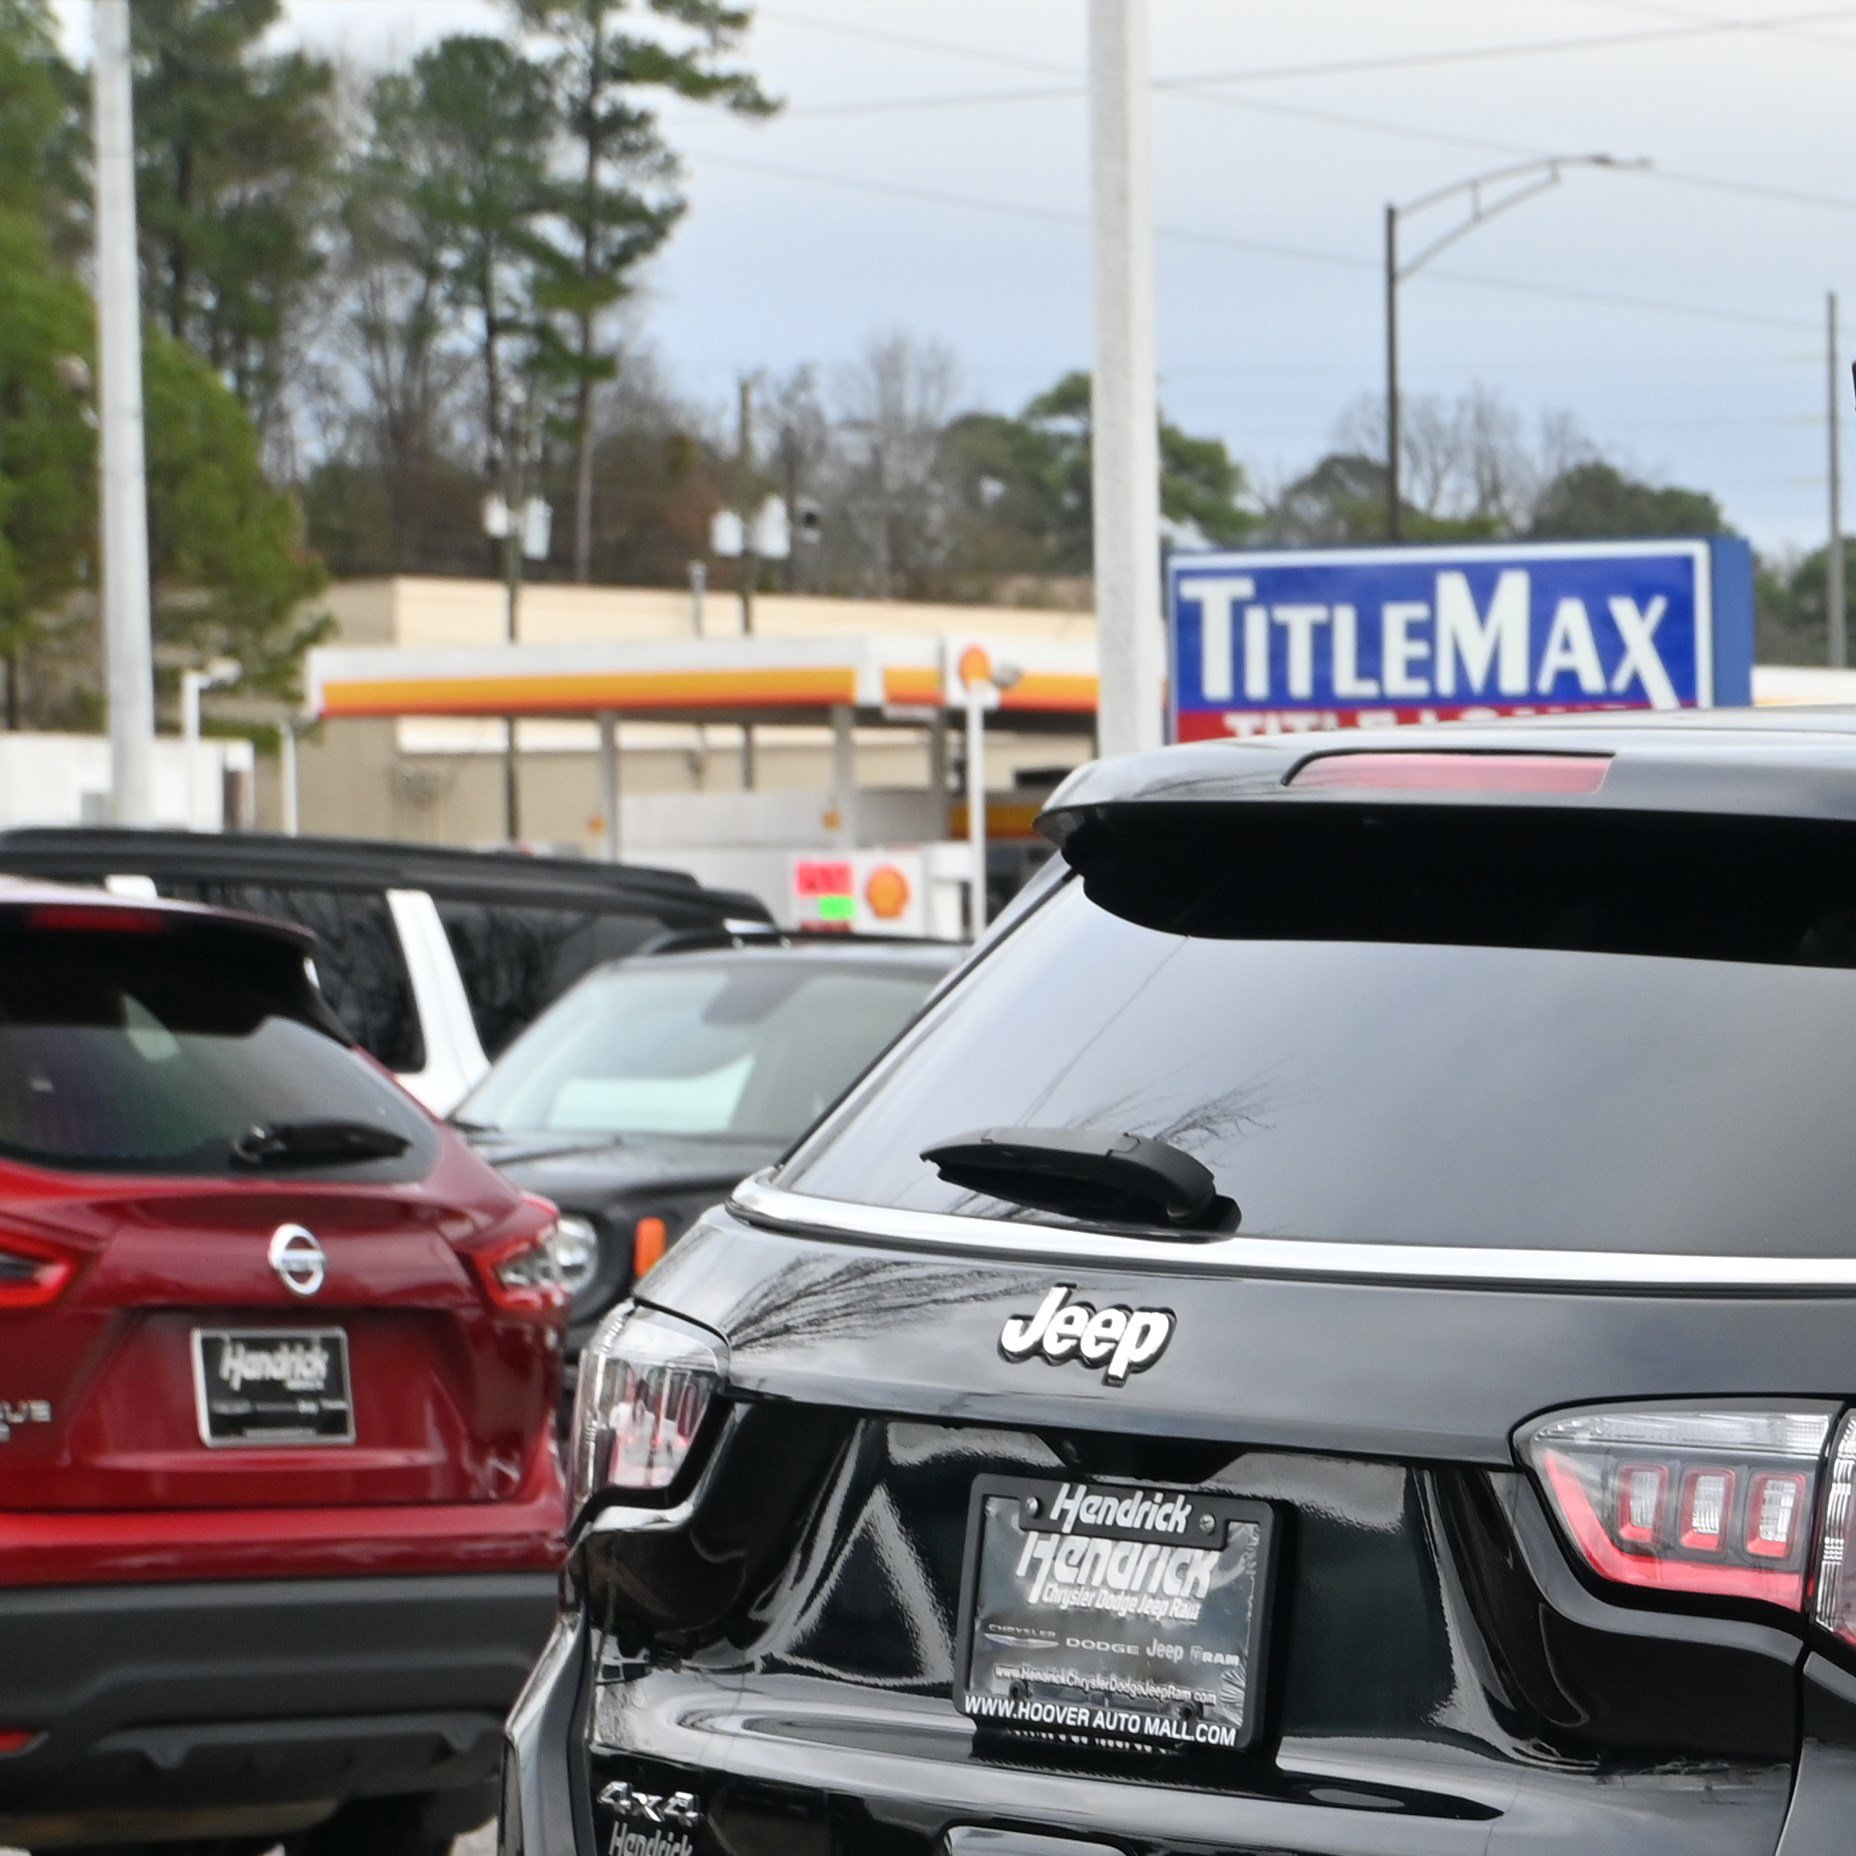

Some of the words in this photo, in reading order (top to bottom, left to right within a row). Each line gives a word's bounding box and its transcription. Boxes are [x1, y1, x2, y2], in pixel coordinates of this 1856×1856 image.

[997, 1282, 1177, 1387] Jeep
[219, 1342, 330, 1392] Hendrick
[0, 1400, 52, 1424] UE
[1049, 1482, 1192, 1534] Hendrick
[1016, 1530, 1222, 1604] Hendrick
[1043, 1583, 1096, 1610] Chrysler
[1095, 1589, 1139, 1617] Dodge
[1138, 1594, 1170, 1621] Jeep
[988, 1623, 1057, 1638] CHRYSLER
[1065, 1637, 1140, 1656] DODGE
[1146, 1638, 1184, 1664] Jeep
[1201, 1651, 1240, 1667] RAM
[964, 1695, 1090, 1728] WWW.HOOVER
[1092, 1710, 1143, 1734] AUTO
[1144, 1717, 1237, 1747] MALL.COM
